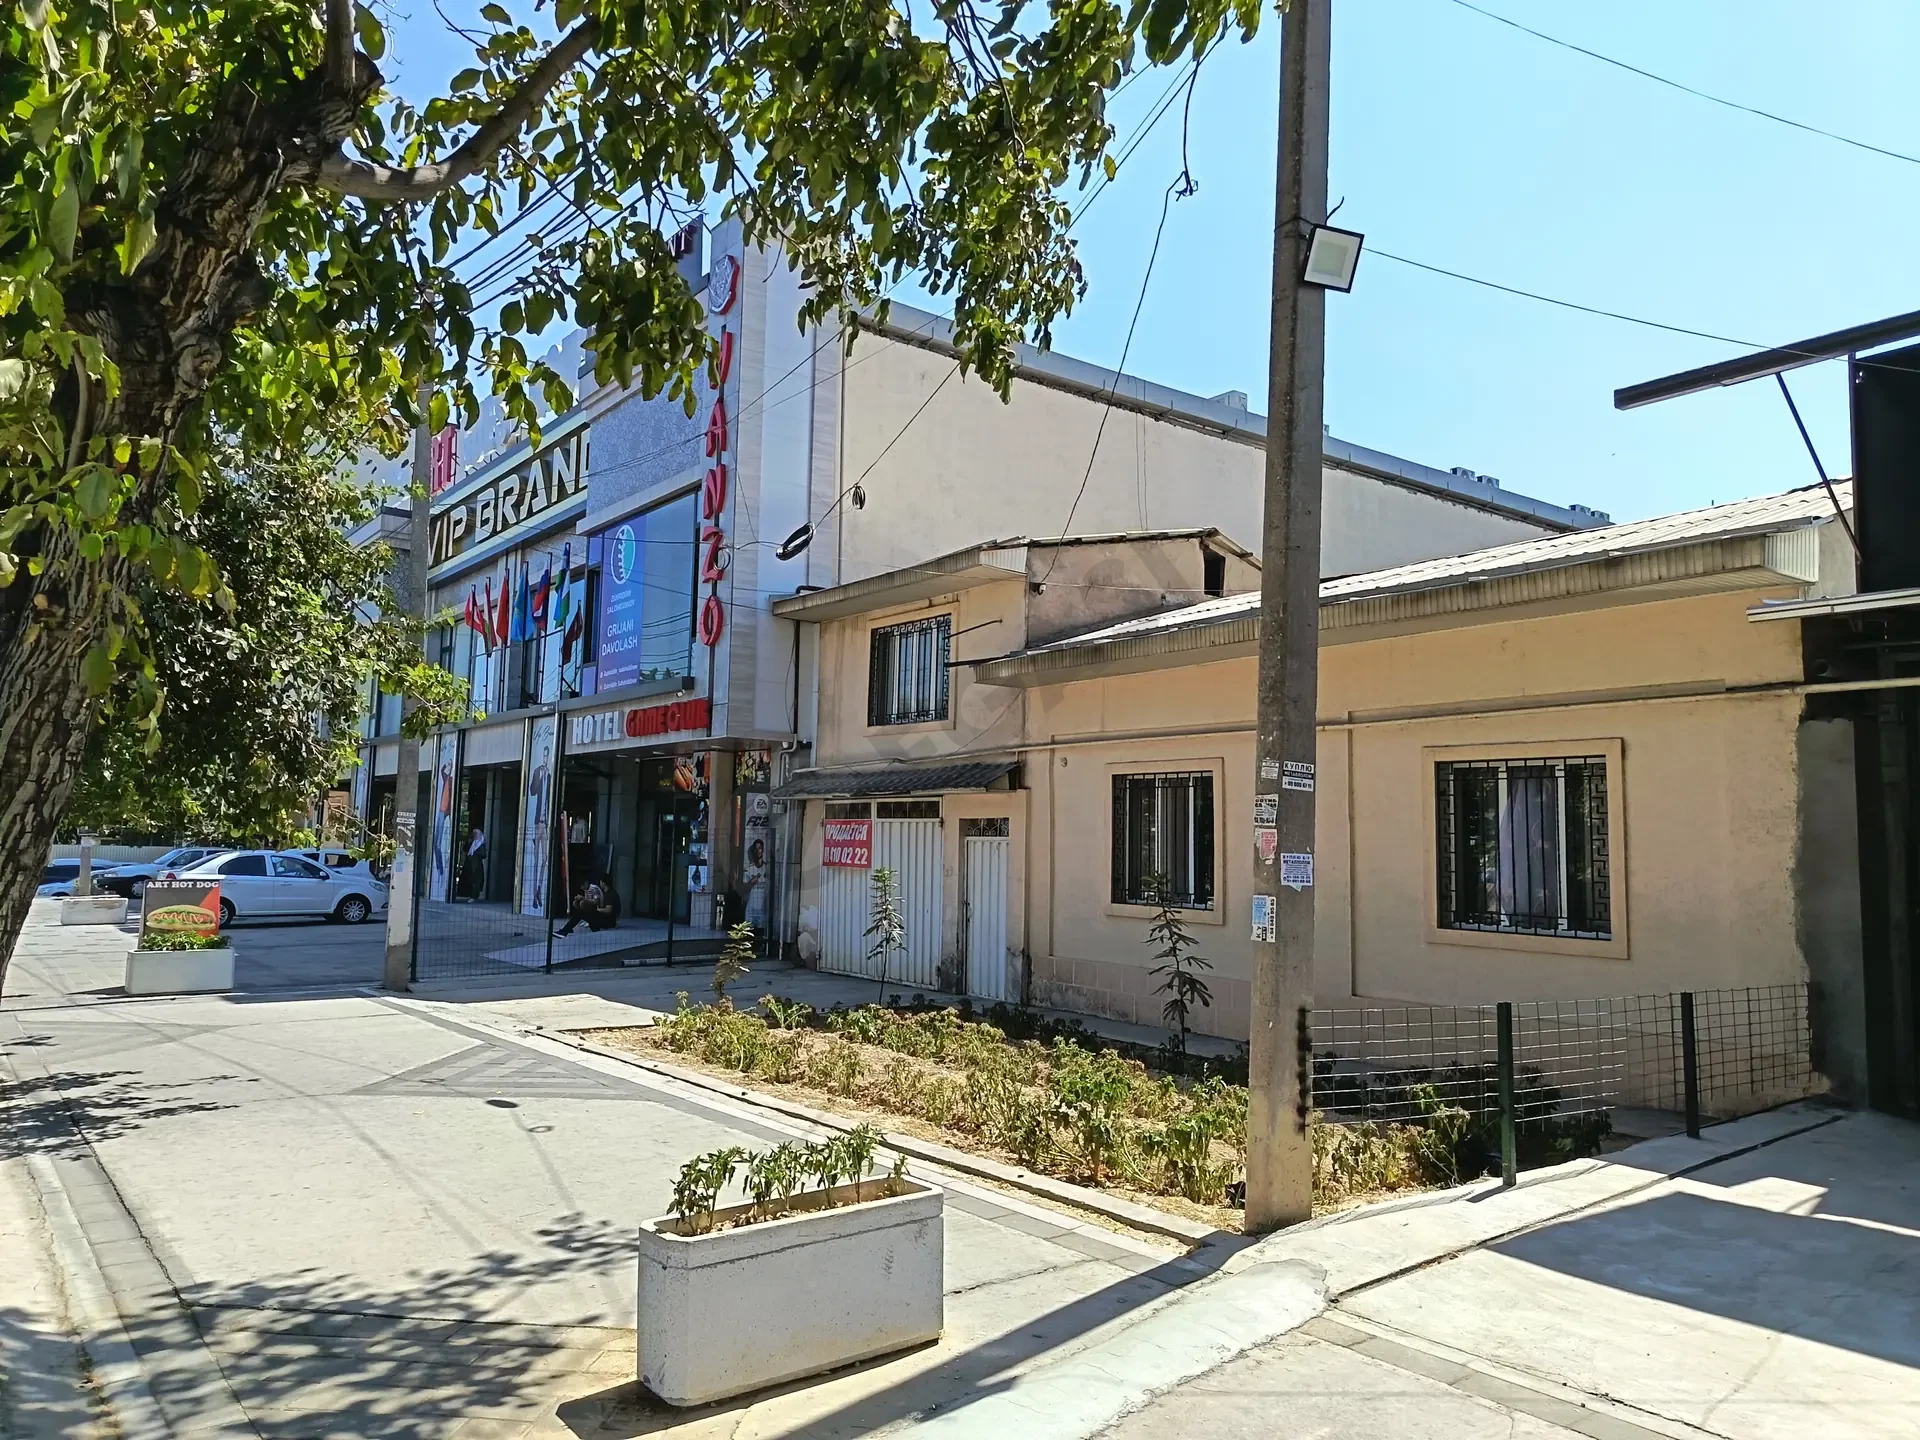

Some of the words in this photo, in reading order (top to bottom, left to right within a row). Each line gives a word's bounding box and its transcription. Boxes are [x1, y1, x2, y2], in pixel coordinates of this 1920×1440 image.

[428, 505, 467, 566] VIP
[607, 620, 634, 637] GRIJANI
[602, 636, 638, 655] DAVOLASH
[572, 710, 620, 745] HOTEL
[1284, 763, 1312, 772] КУПЛЮ
[825, 822, 868, 842] ПРОДАЁТСЯ
[841, 847, 853, 864] 02
[854, 848, 868, 865] 22
